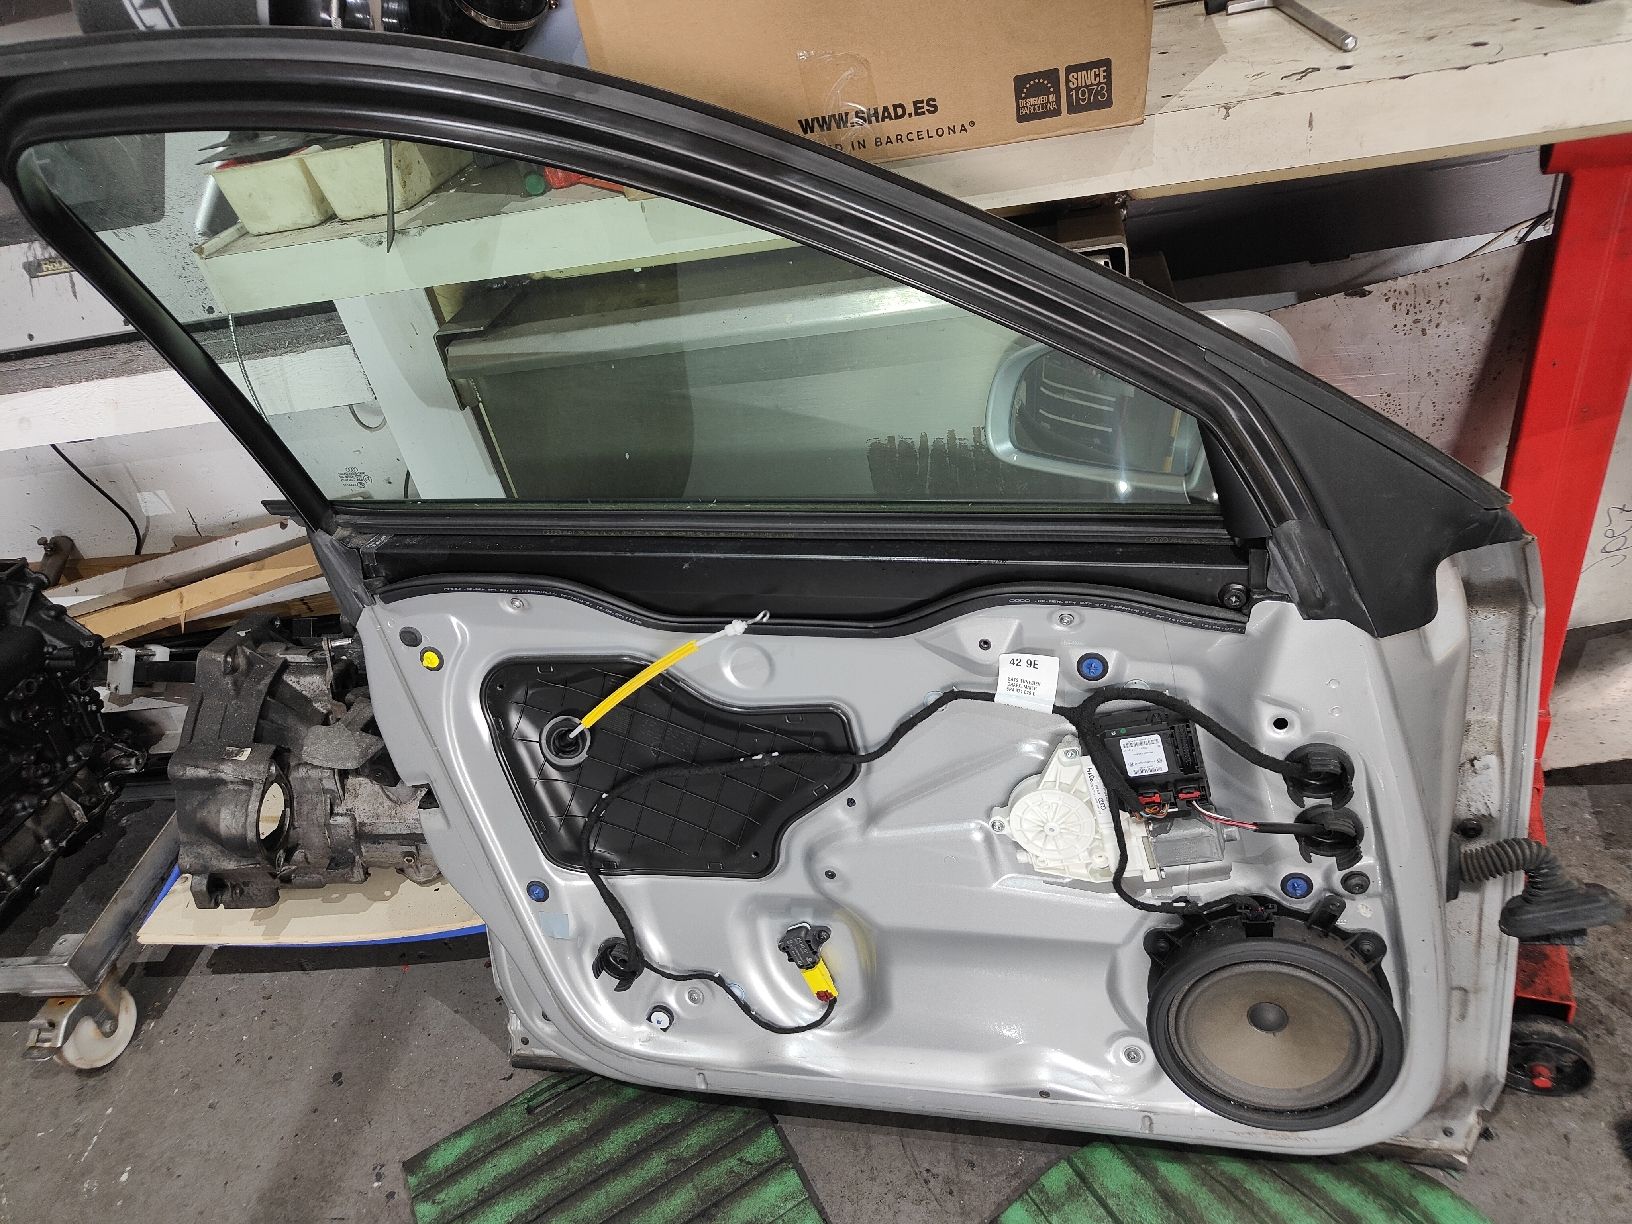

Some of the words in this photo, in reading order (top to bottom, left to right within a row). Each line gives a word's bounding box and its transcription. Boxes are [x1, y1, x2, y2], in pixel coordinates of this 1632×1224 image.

[1068, 67, 1107, 88] SINCE
[1019, 96, 1048, 107] DESIGNED
[1070, 84, 1108, 106] 1973
[1019, 102, 1058, 115] BARCELONA
[797, 97, 939, 135] WWW.SHAD.ES
[851, 139, 867, 151] IN
[1009, 658, 1022, 667] 42
[1026, 658, 1039, 670] 9E
